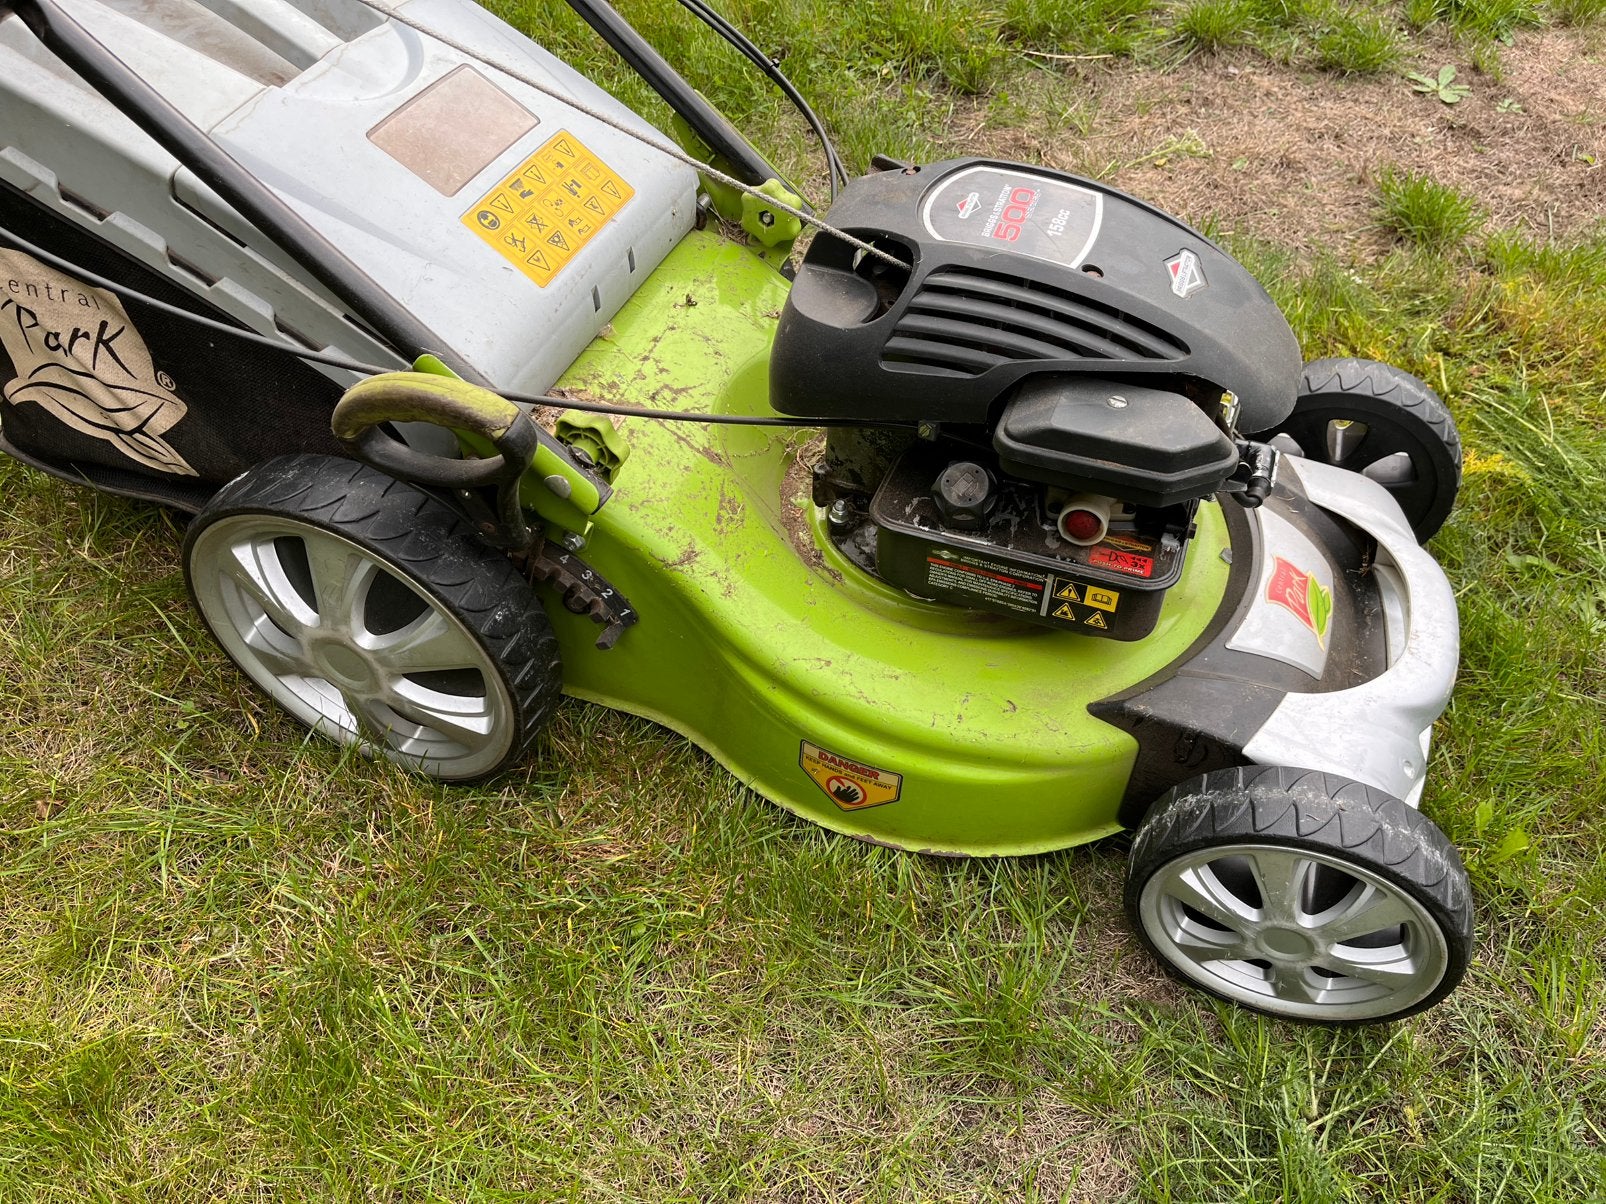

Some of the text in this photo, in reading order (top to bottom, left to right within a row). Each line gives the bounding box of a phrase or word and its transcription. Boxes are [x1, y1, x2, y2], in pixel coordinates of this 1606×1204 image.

[993, 187, 1036, 242] 500
[1049, 209, 1071, 237] 158cc
[0, 280, 100, 310] entral
[559, 554, 631, 617] 4 3 2 1
[1285, 569, 1309, 618] Park
[805, 755, 821, 765] KEEP
[821, 761, 843, 775] HANDS
[873, 782, 892, 791] AWAY
[818, 750, 880, 780] DANGER
